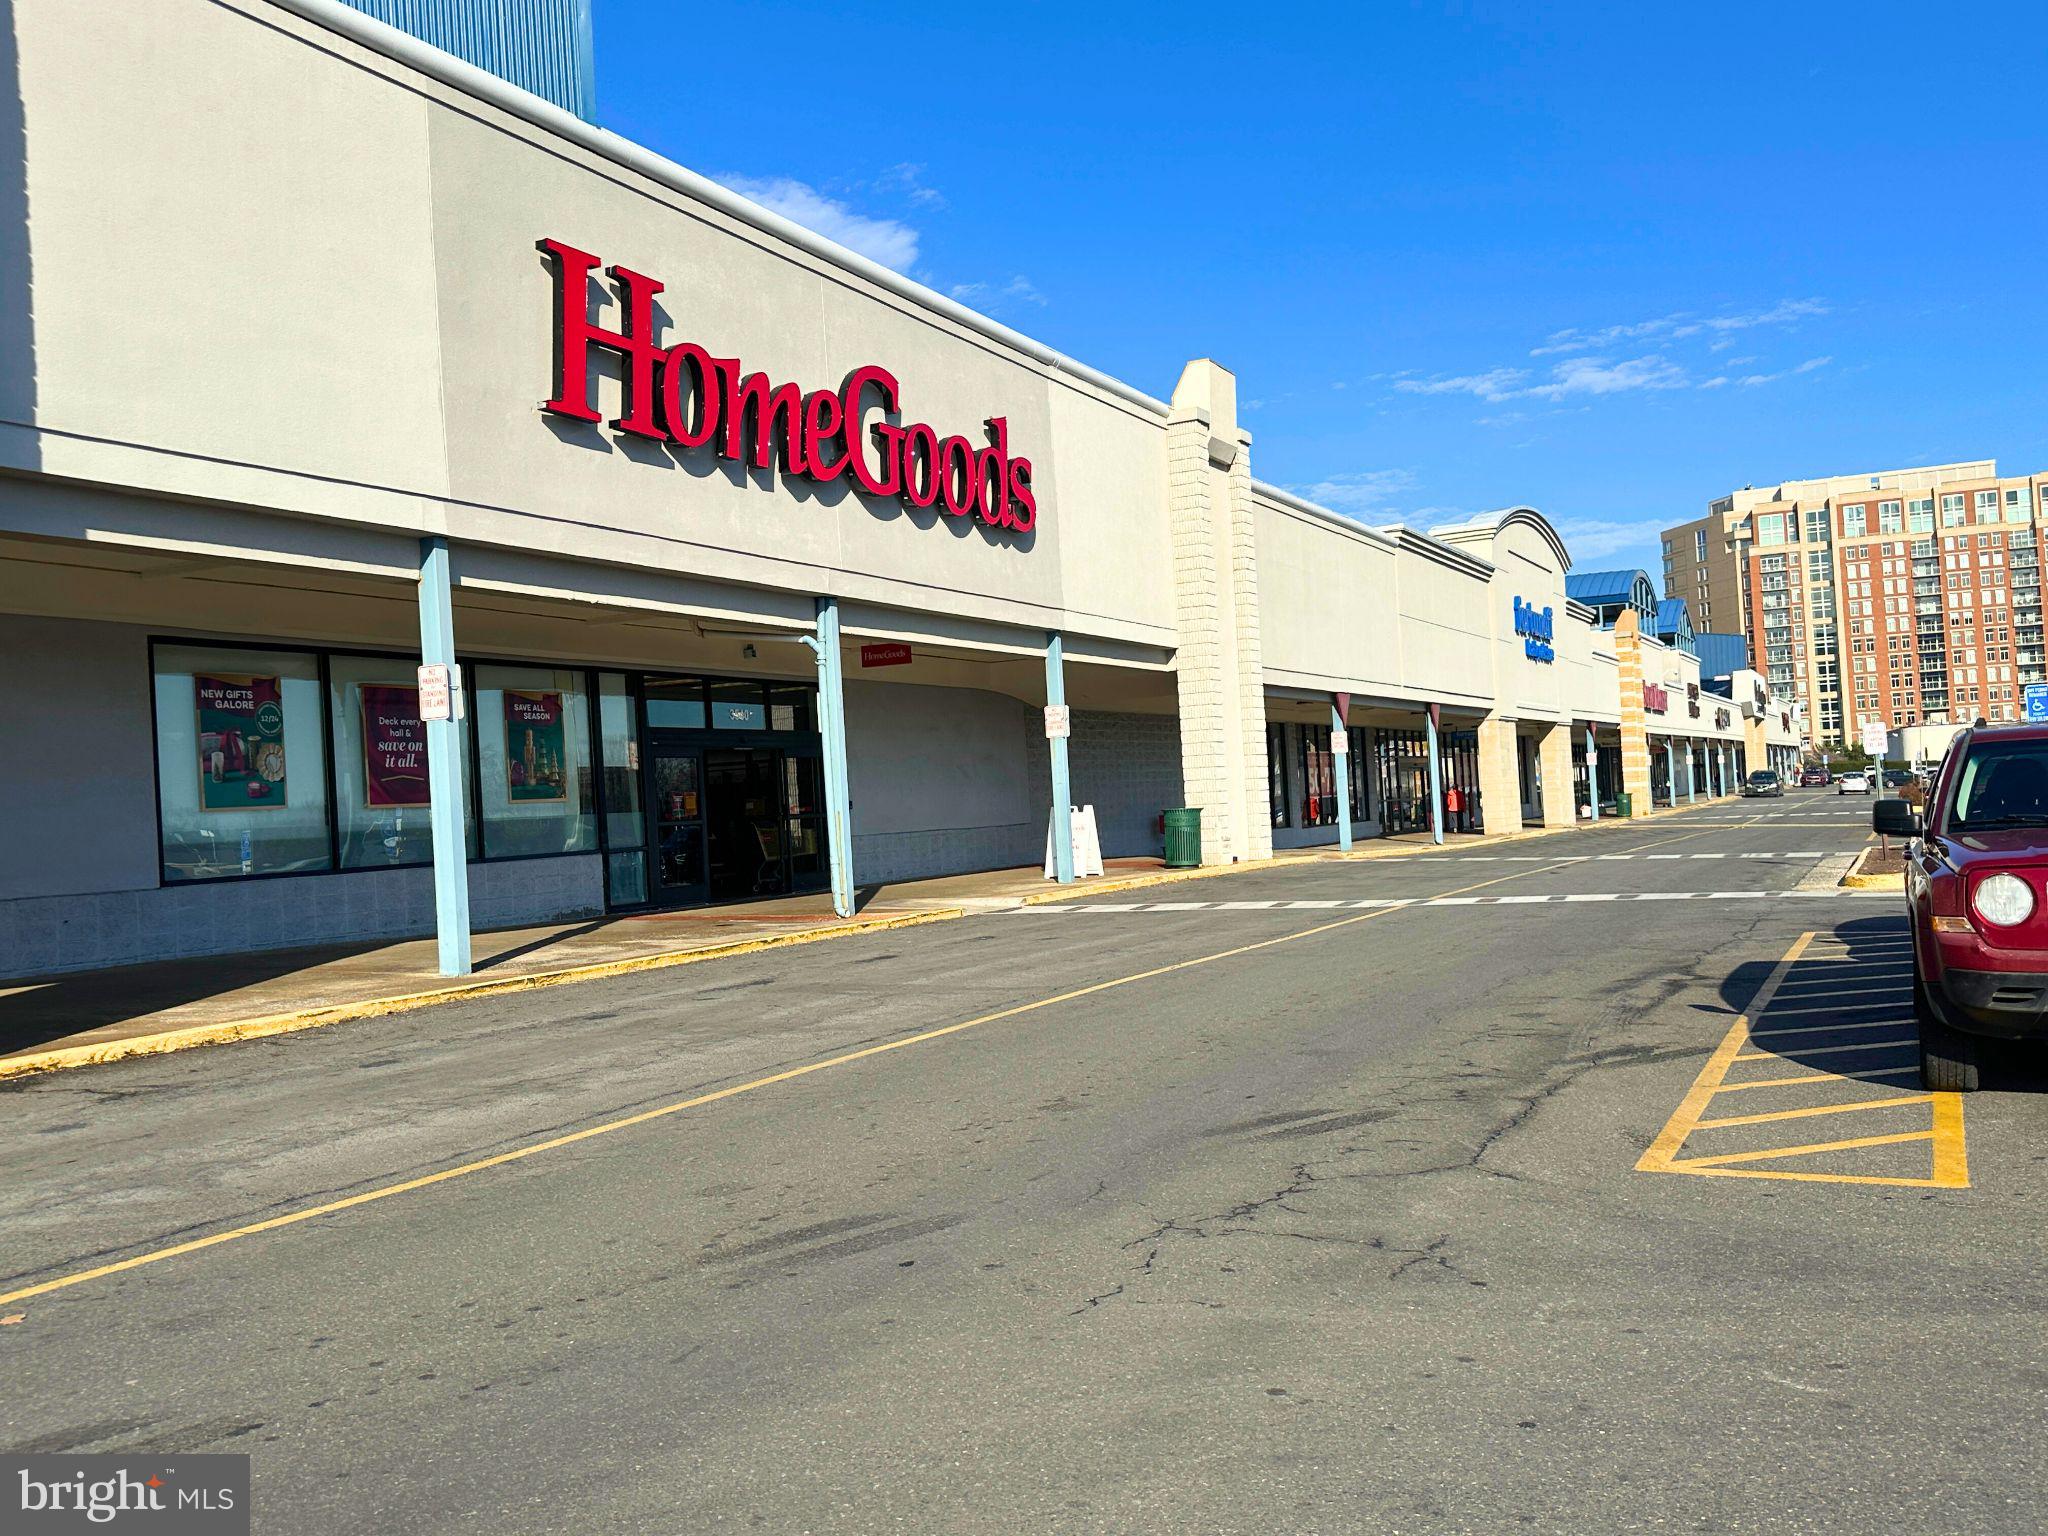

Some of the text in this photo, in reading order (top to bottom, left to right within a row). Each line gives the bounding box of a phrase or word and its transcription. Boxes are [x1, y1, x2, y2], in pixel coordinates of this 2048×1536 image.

[536, 238, 1036, 533] HomeGoods
[201, 689, 254, 699] NEW GIFTS
[215, 700, 255, 709] GALORE
[514, 703, 531, 711] SAVE
[523, 712, 550, 720] SEASON
[378, 717, 421, 728] Deck every
[389, 728, 412, 738] hall &
[377, 741, 423, 752] save on
[385, 754, 418, 768] it all.
